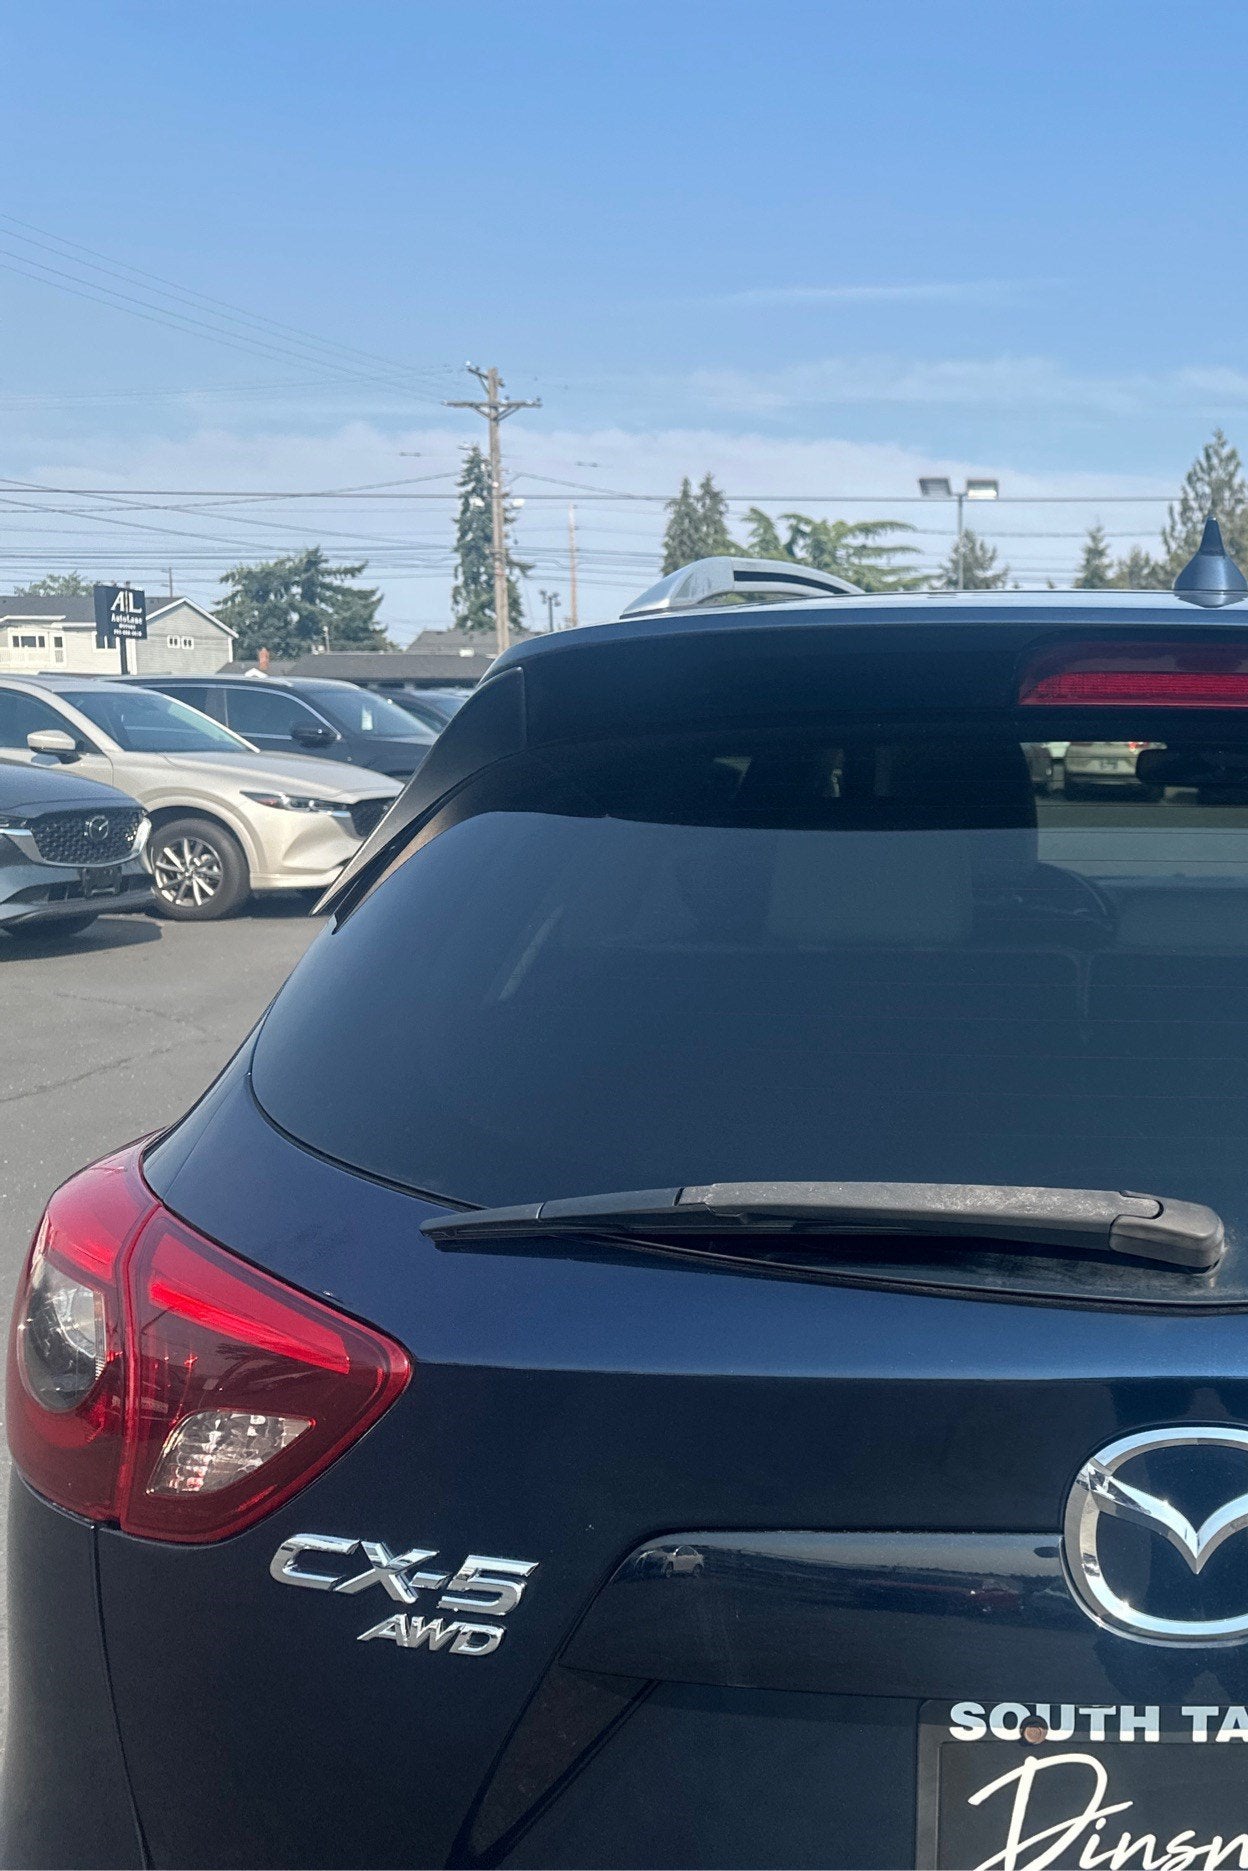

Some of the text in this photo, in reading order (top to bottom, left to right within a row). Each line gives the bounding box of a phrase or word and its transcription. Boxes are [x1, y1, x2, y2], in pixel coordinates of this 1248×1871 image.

[269, 1533, 539, 1616] CX-5
[357, 1613, 506, 1656] AWD
[949, 1701, 1160, 1742] SOUTH
